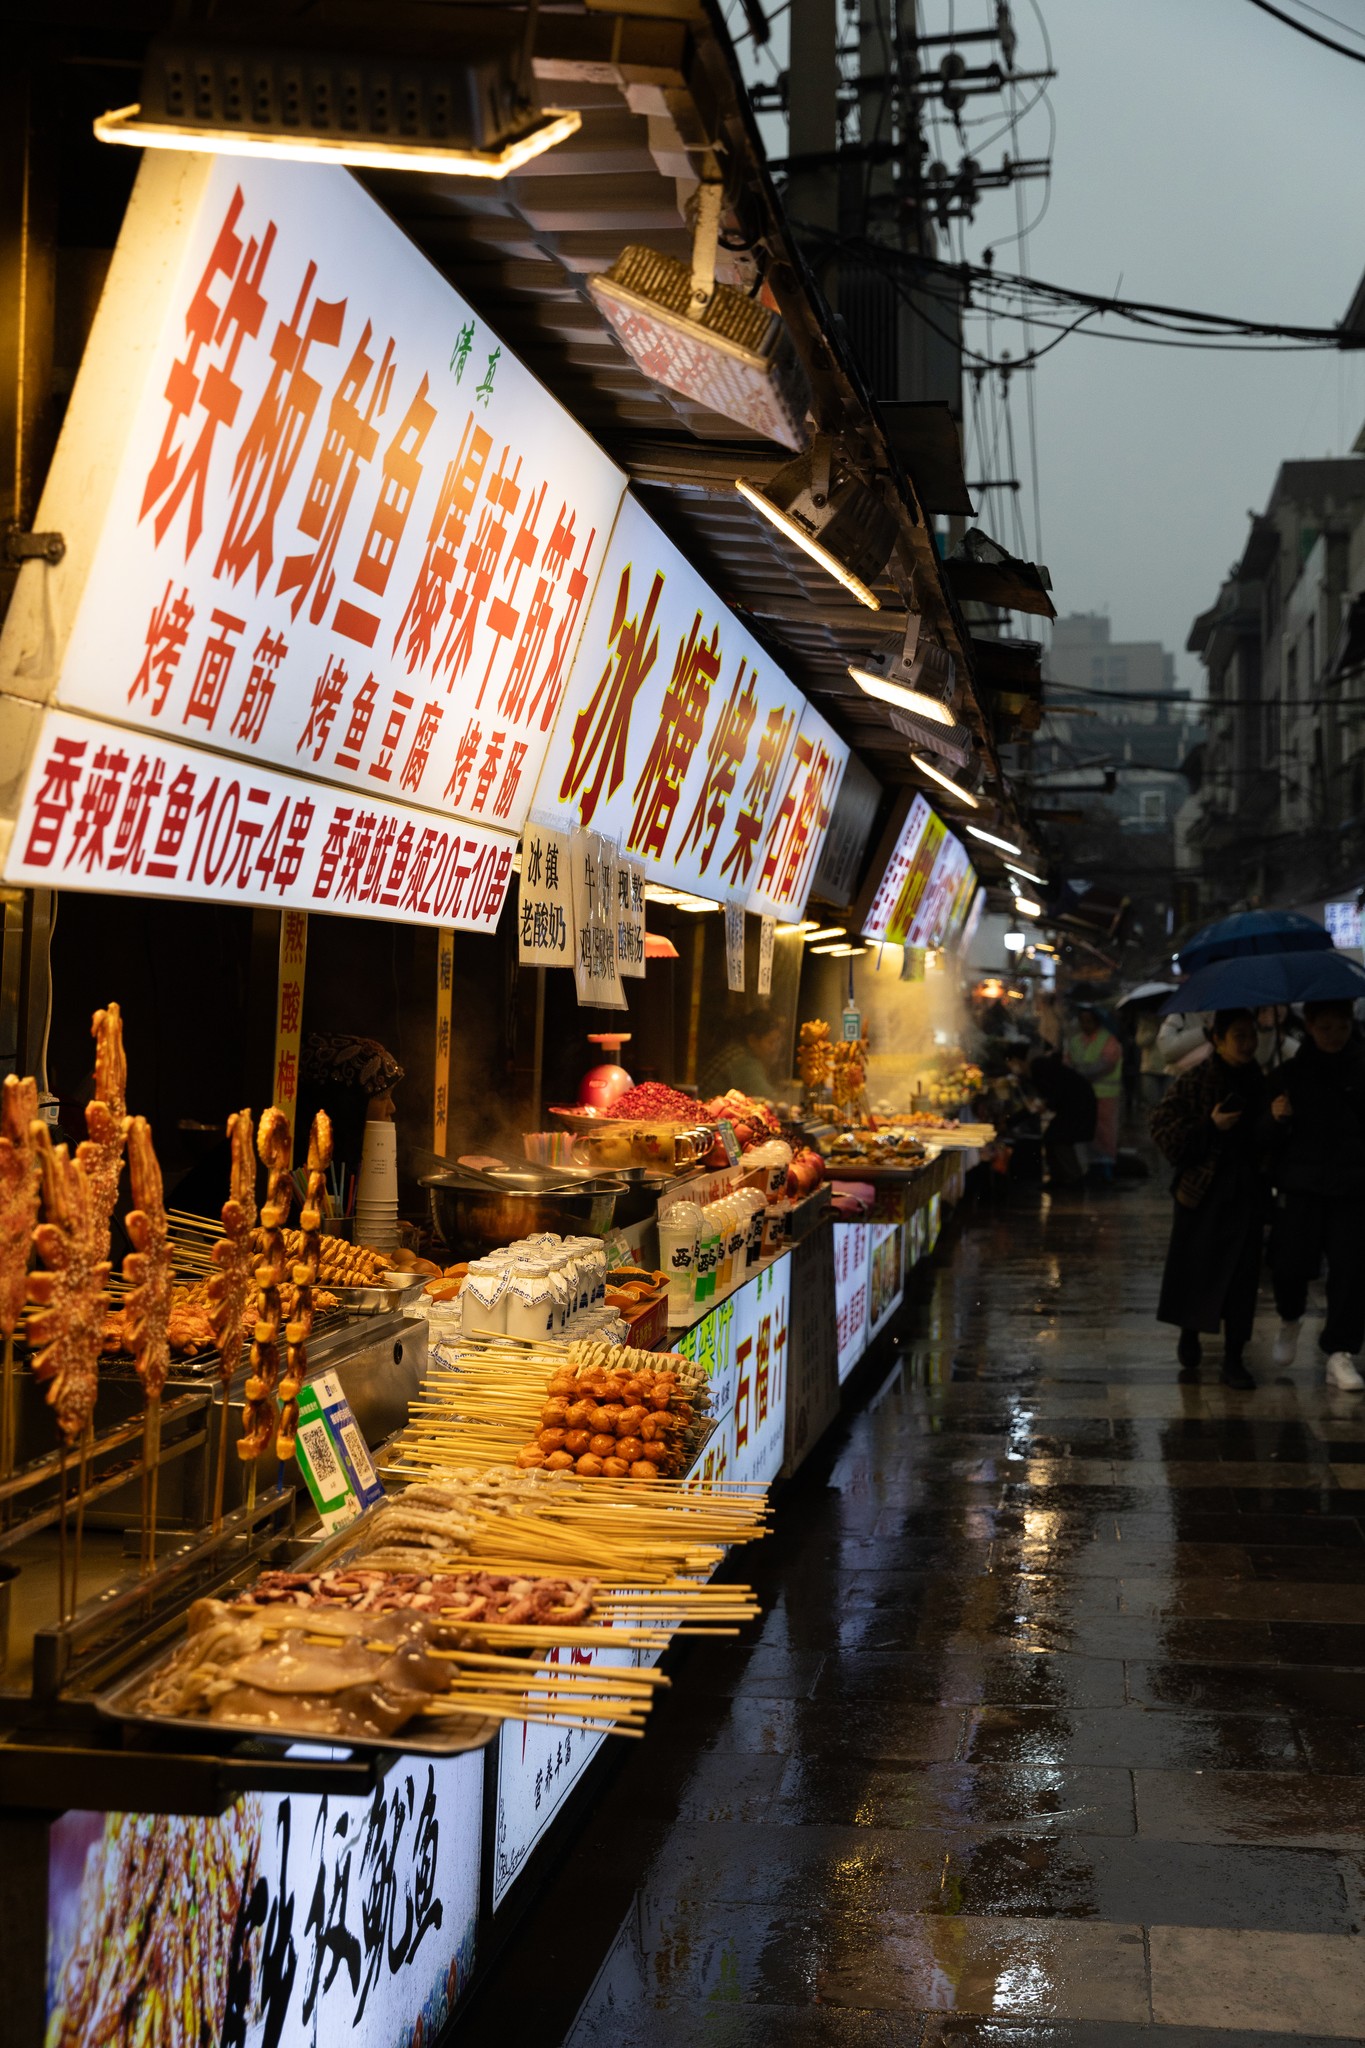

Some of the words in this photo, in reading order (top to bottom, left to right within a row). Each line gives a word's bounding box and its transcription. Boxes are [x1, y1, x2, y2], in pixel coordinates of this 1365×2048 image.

[450, 320, 501, 408] 清真
[137, 182, 438, 648] 铁板鱿鱼
[391, 410, 597, 732] 爆辣牛筋丸
[128, 579, 289, 744] 烤面筋
[297, 653, 444, 793] 烤鱼豆腐
[442, 717, 529, 819] 烤香肠
[558, 561, 796, 888] 冰糖烤梨
[23, 736, 316, 897] 香辣鱿鱼10元4串
[312, 807, 512, 924] 香辣鱿鱼须20元10串
[527, 838, 559, 890] 冰镇
[757, 733, 843, 909] 石榴汁
[520, 899, 566, 951] 老酸奶
[618, 921, 643, 964] 酸梅汤
[734, 1296, 786, 1460] 石榴汁
